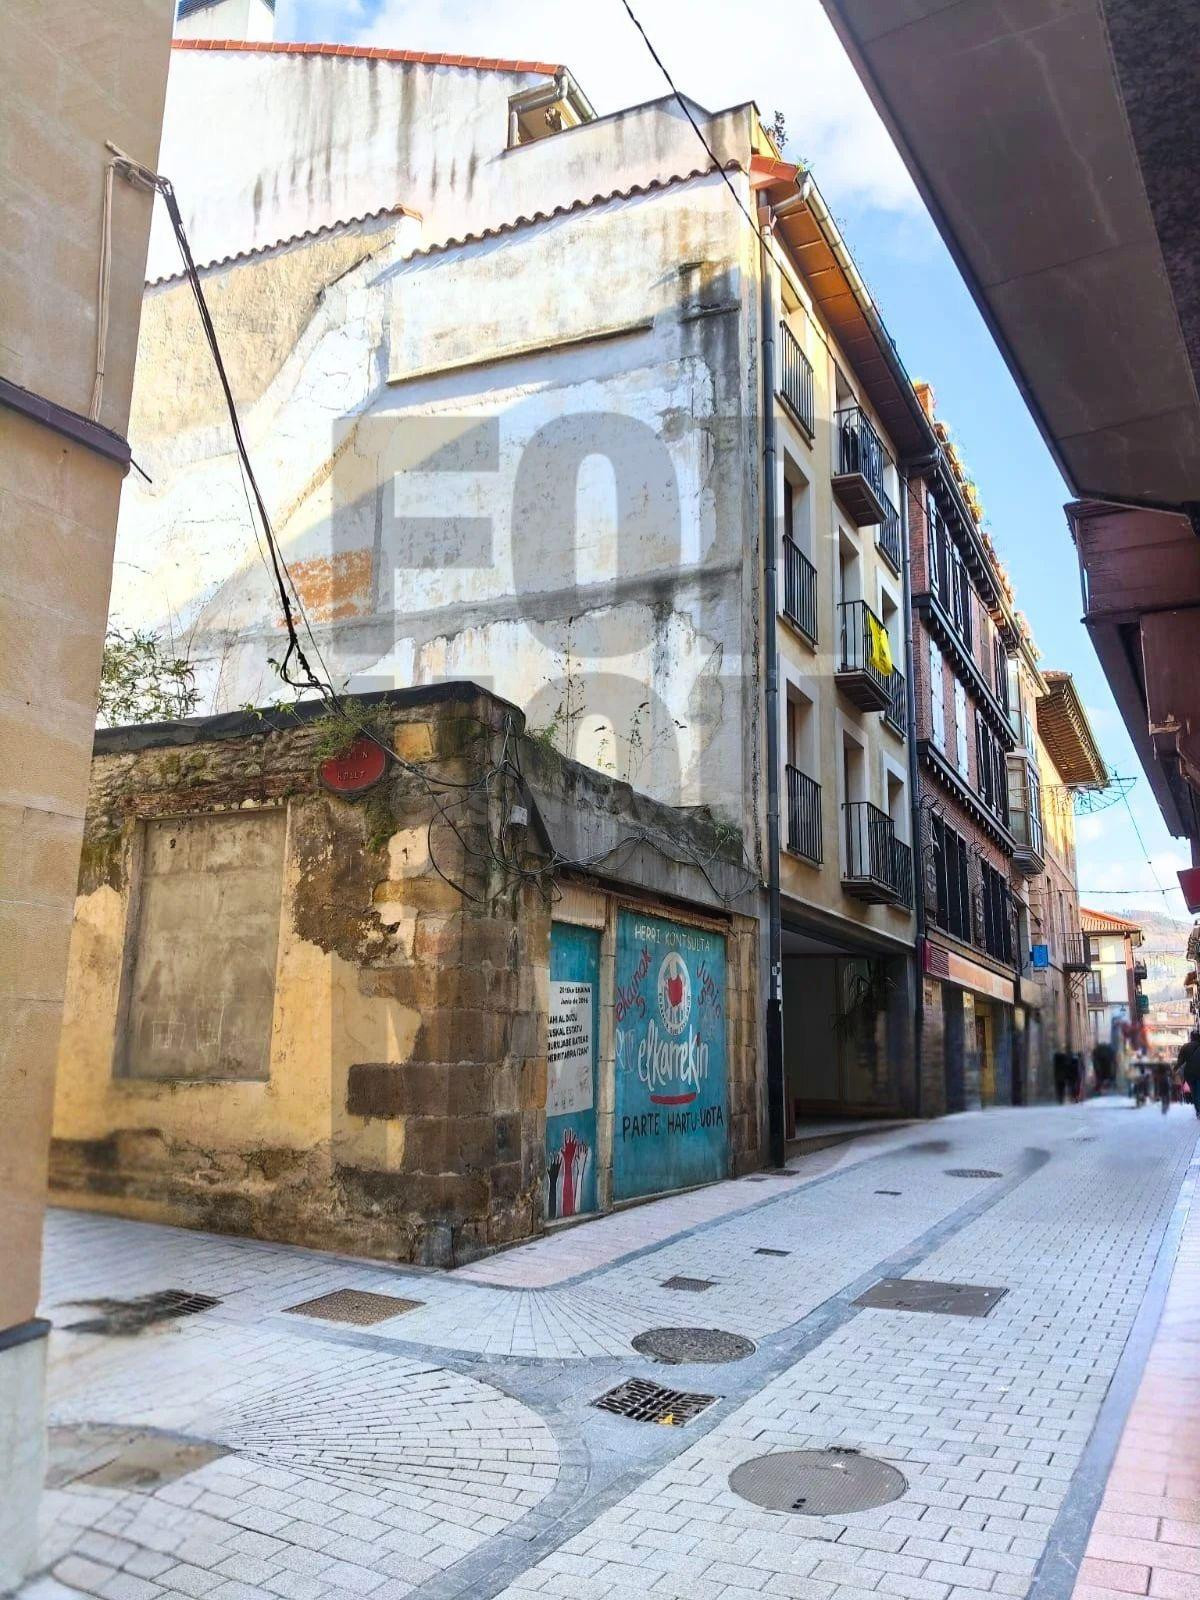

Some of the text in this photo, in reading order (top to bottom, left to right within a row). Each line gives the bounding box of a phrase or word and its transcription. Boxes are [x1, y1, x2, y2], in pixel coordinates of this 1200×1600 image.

[634, 923, 710, 952] HERRI KONTSULTA
[637, 1018, 709, 1093] elkarrekin
[622, 1113, 660, 1143] PARTE
